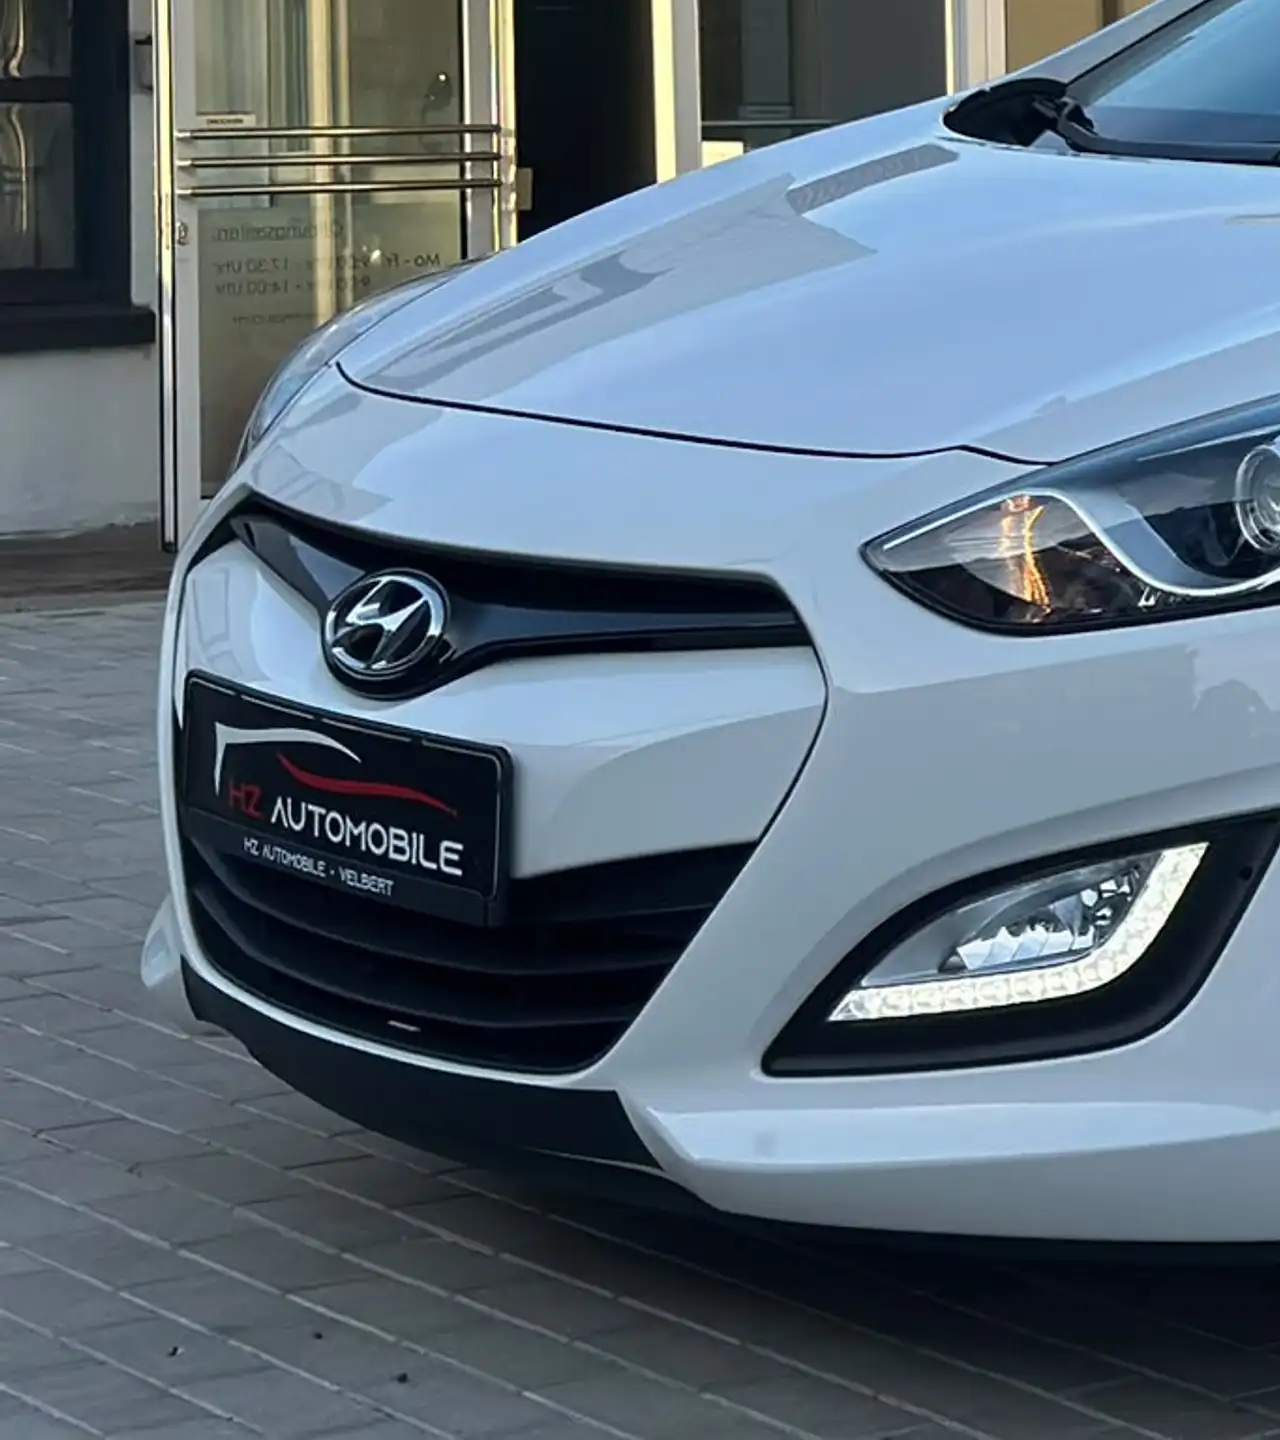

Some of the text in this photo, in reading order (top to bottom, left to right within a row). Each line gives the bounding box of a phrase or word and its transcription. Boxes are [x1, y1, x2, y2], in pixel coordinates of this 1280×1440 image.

[228, 779, 463, 876] HZ AUTOMOBILE
[243, 837, 260, 856] HZ
[262, 843, 326, 878] AUTOMOBILE
[339, 867, 395, 896] VELBERT
